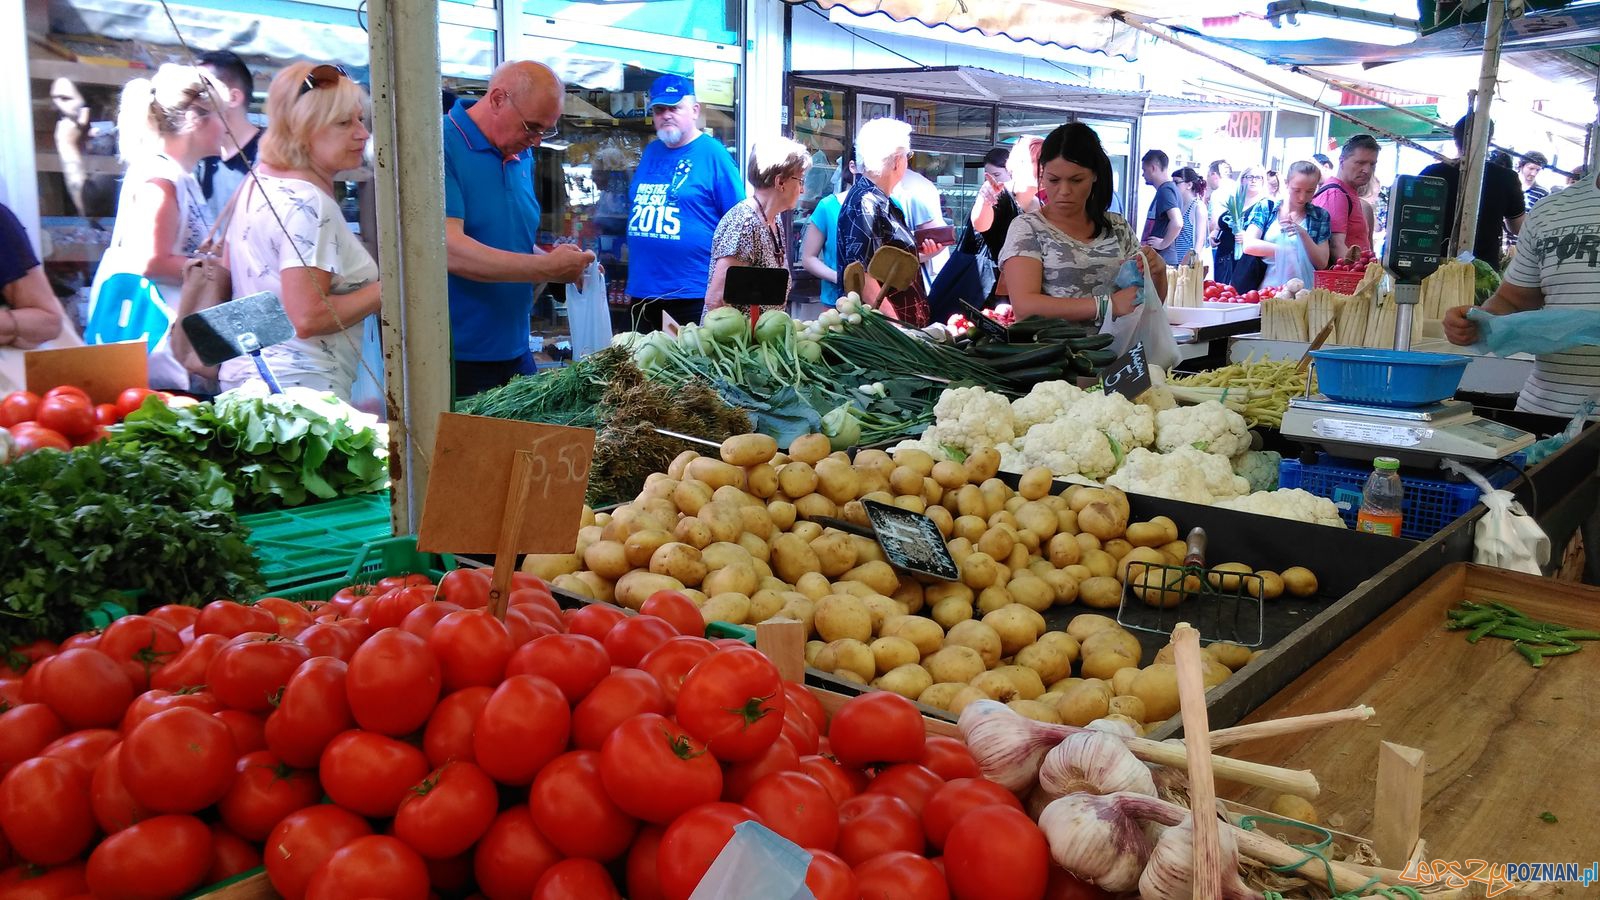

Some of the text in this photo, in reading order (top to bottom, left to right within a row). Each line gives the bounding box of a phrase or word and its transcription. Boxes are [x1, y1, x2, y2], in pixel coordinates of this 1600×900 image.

[636, 183, 670, 195] MISTRZ
[633, 194, 667, 206] POLSKI
[628, 204, 681, 235] 2015
[531, 428, 588, 499] 5,50
